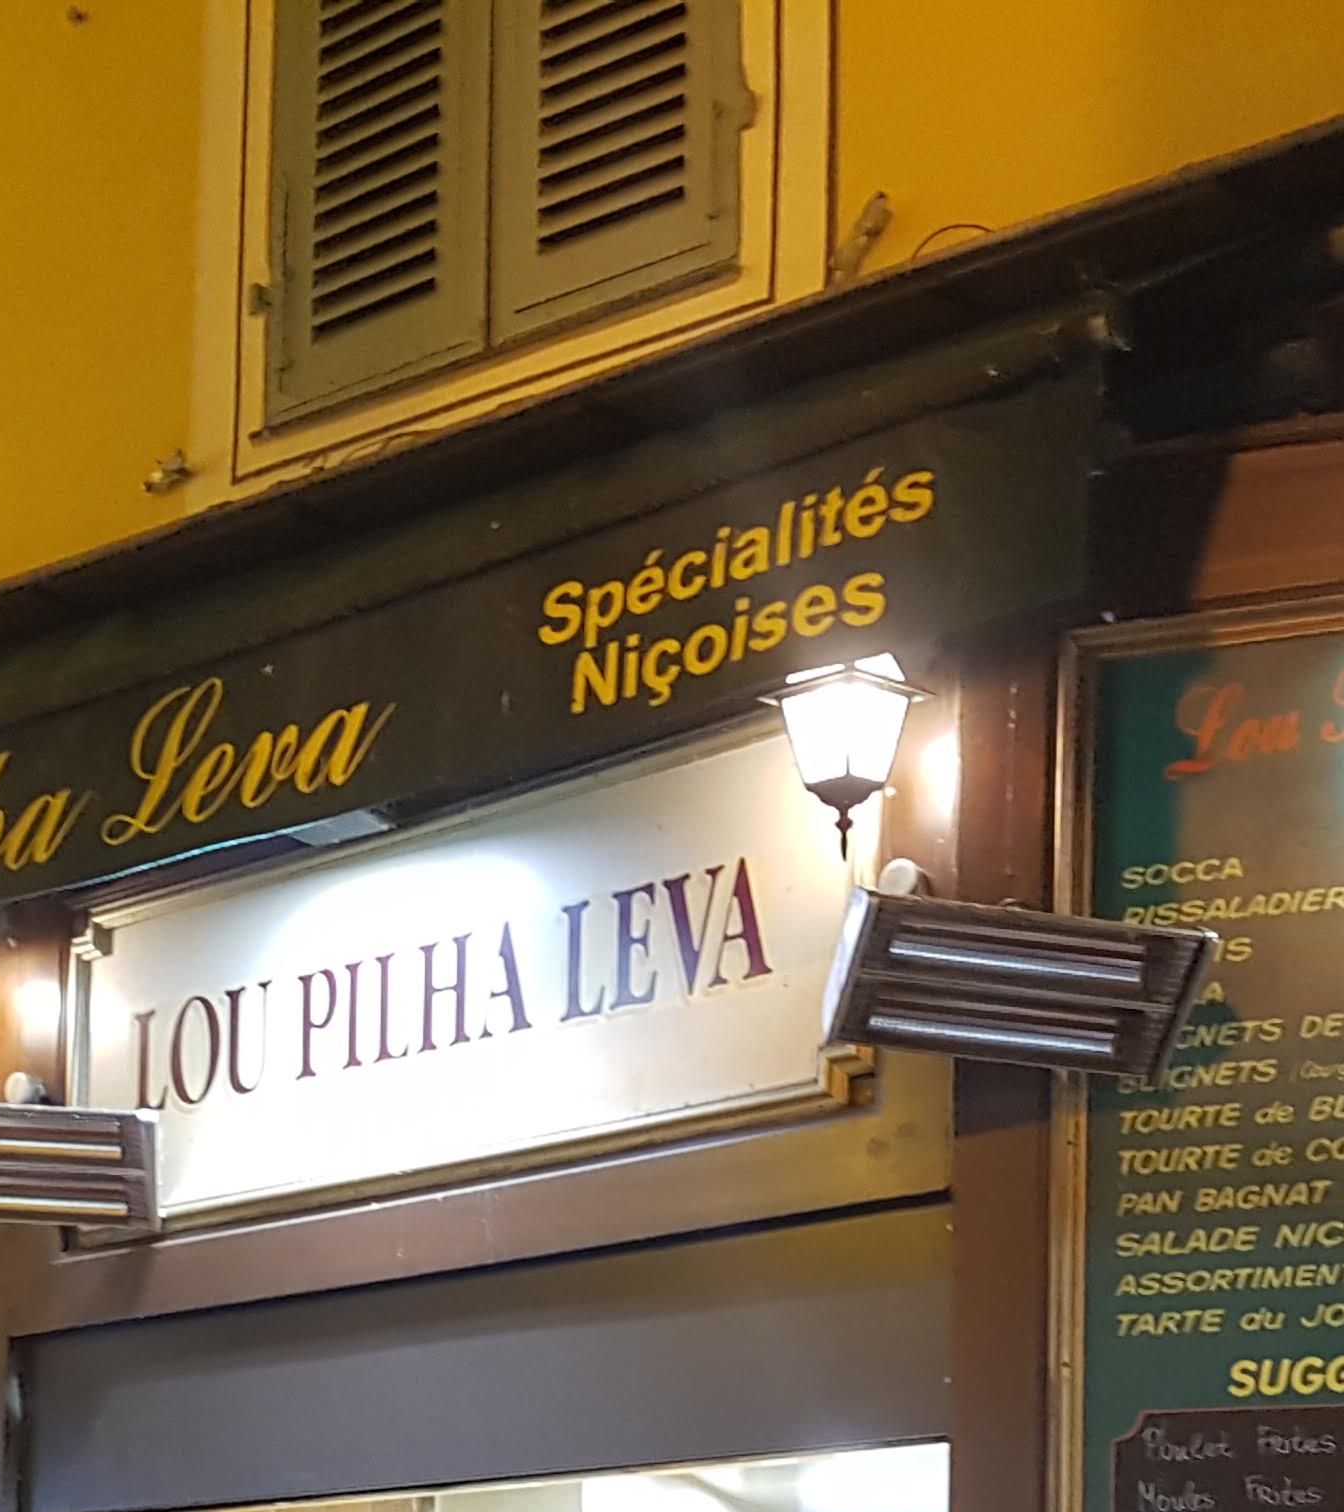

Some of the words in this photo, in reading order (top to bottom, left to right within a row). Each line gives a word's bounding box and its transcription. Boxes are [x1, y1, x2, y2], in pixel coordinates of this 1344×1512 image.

[537, 467, 936, 648] Spécialités
[572, 569, 886, 714] Niçoises
[1164, 682, 1302, 780] Lou
[101, 677, 397, 846] Leva
[1121, 857, 1244, 889] SOCCA
[136, 980, 272, 1112] LOU
[294, 920, 531, 1080] PILHA
[558, 855, 773, 1025] LEVA
[1174, 1018, 1284, 1049] GNETS
[1120, 1103, 1242, 1135] TOURTE
[1255, 1102, 1294, 1125] de
[1117, 1142, 1243, 1176] TOURTE
[1251, 1141, 1294, 1167] de
[1116, 1190, 1183, 1217] PAN
[1194, 1179, 1332, 1212] BAGNAT
[1115, 1226, 1259, 1257] SALADE
[1116, 1308, 1226, 1337] TARTE
[1239, 1306, 1286, 1331] du
